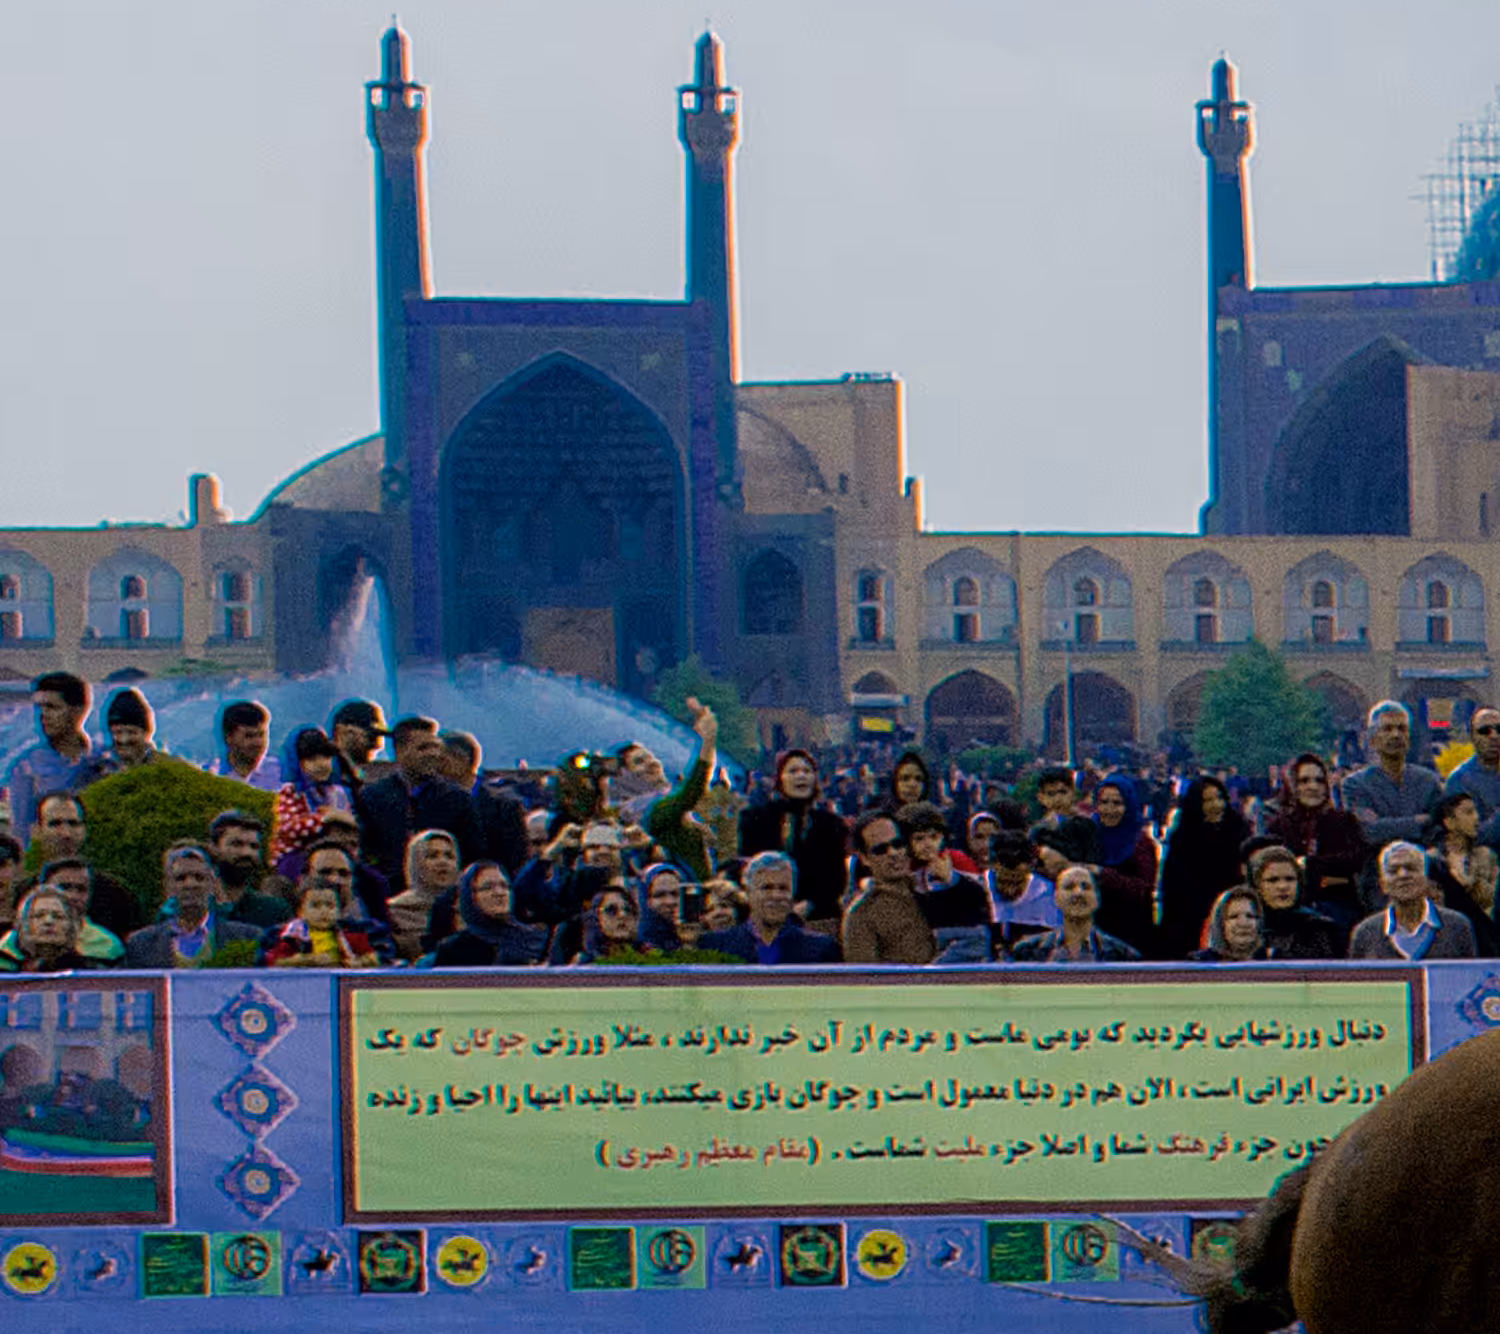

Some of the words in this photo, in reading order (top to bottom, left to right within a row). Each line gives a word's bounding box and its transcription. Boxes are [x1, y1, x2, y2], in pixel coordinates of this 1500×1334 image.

[366, 1027, 406, 1055] یک
[413, 1027, 443, 1051] که
[450, 1027, 527, 1058] چوگان
[531, 1027, 605, 1059] ورزش
[611, 1024, 655, 1051] مثلا
[759, 1023, 800, 1055] خبر
[808, 1020, 843, 1053] آن
[851, 1022, 875, 1052] از
[878, 1027, 938, 1053] مردم
[945, 1029, 959, 1052] و
[965, 1021, 1030, 1046] ماست
[1033, 1027, 1092, 1052] بومی
[1098, 1020, 1126, 1044] که
[1132, 1021, 1209, 1050] بگردید
[1328, 1019, 1387, 1047] دنبال
[366, 1084, 422, 1116] زنده
[444, 1082, 494, 1112] احیا
[495, 1082, 521, 1114] را
[523, 1082, 573, 1112] اینها
[728, 1080, 782, 1111] بازی
[787, 1078, 863, 1111] چوگان
[866, 1088, 880, 1110] و
[885, 1079, 937, 1102] است
[938, 1078, 1011, 1109] معمول
[1013, 1077, 1056, 1106] دنیا
[1059, 1082, 1088, 1108] در
[1091, 1081, 1124, 1106] هم
[1127, 1075, 1174, 1105] الان
[1244, 1075, 1315, 1105] ایرانی
[1317, 1075, 1389, 1105] ورزش
[426, 1095, 441, 1116] و
[695, 1134, 755, 1167] معظم
[933, 1134, 987, 1163] ملیت
[990, 1139, 1035, 1165] جزء
[1040, 1133, 1089, 1157] اصلا
[1094, 1144, 1108, 1163] و
[1110, 1133, 1149, 1155] شما
[1155, 1132, 1230, 1162] فرهنگ
[1234, 1135, 1279, 1162] جزء
